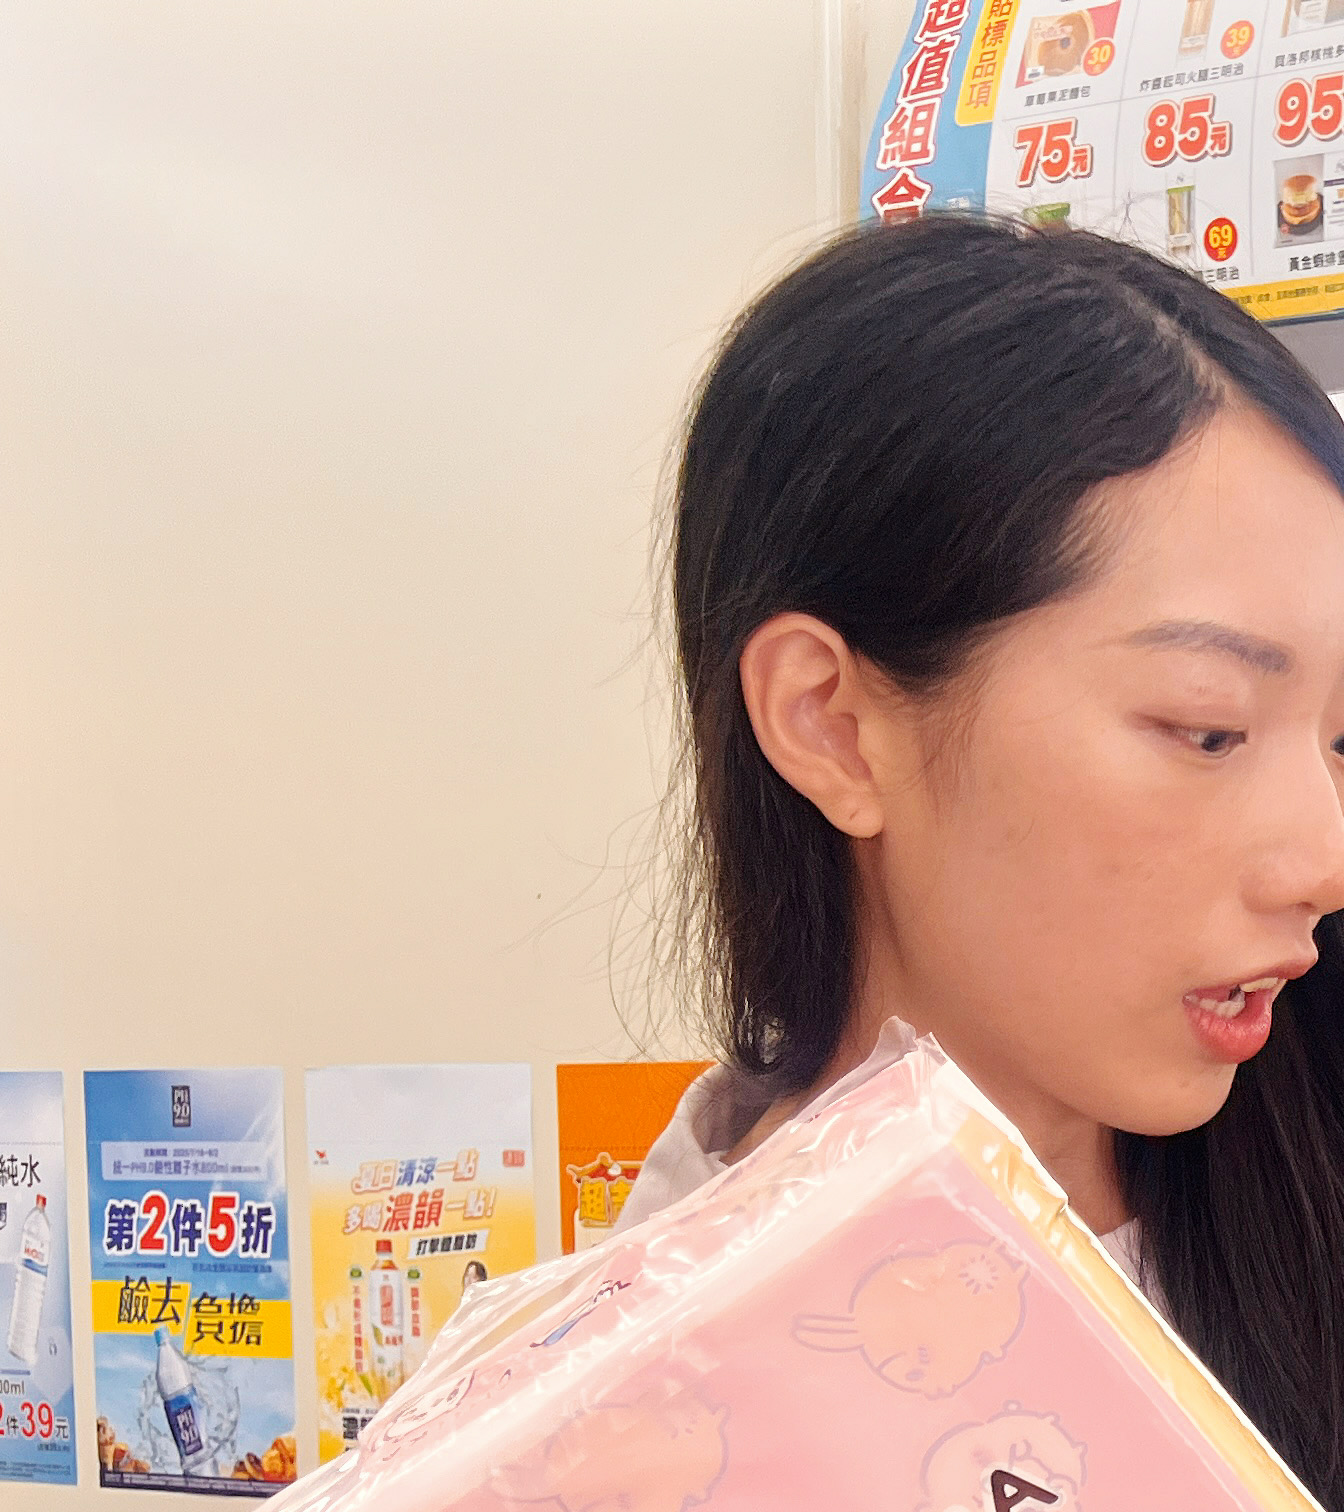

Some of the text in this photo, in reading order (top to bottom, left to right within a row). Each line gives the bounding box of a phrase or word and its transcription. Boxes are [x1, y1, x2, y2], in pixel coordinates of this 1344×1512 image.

[1088, 45, 1111, 64] 30
[1226, 27, 1251, 48] 39
[1016, 120, 1090, 184] 75元
[1145, 96, 1229, 164] 85元
[1208, 225, 1233, 247] 69
[105, 1193, 274, 1254] 第2件5折
[117, 1275, 184, 1326] 鹼去
[191, 1290, 264, 1346] 負擔
